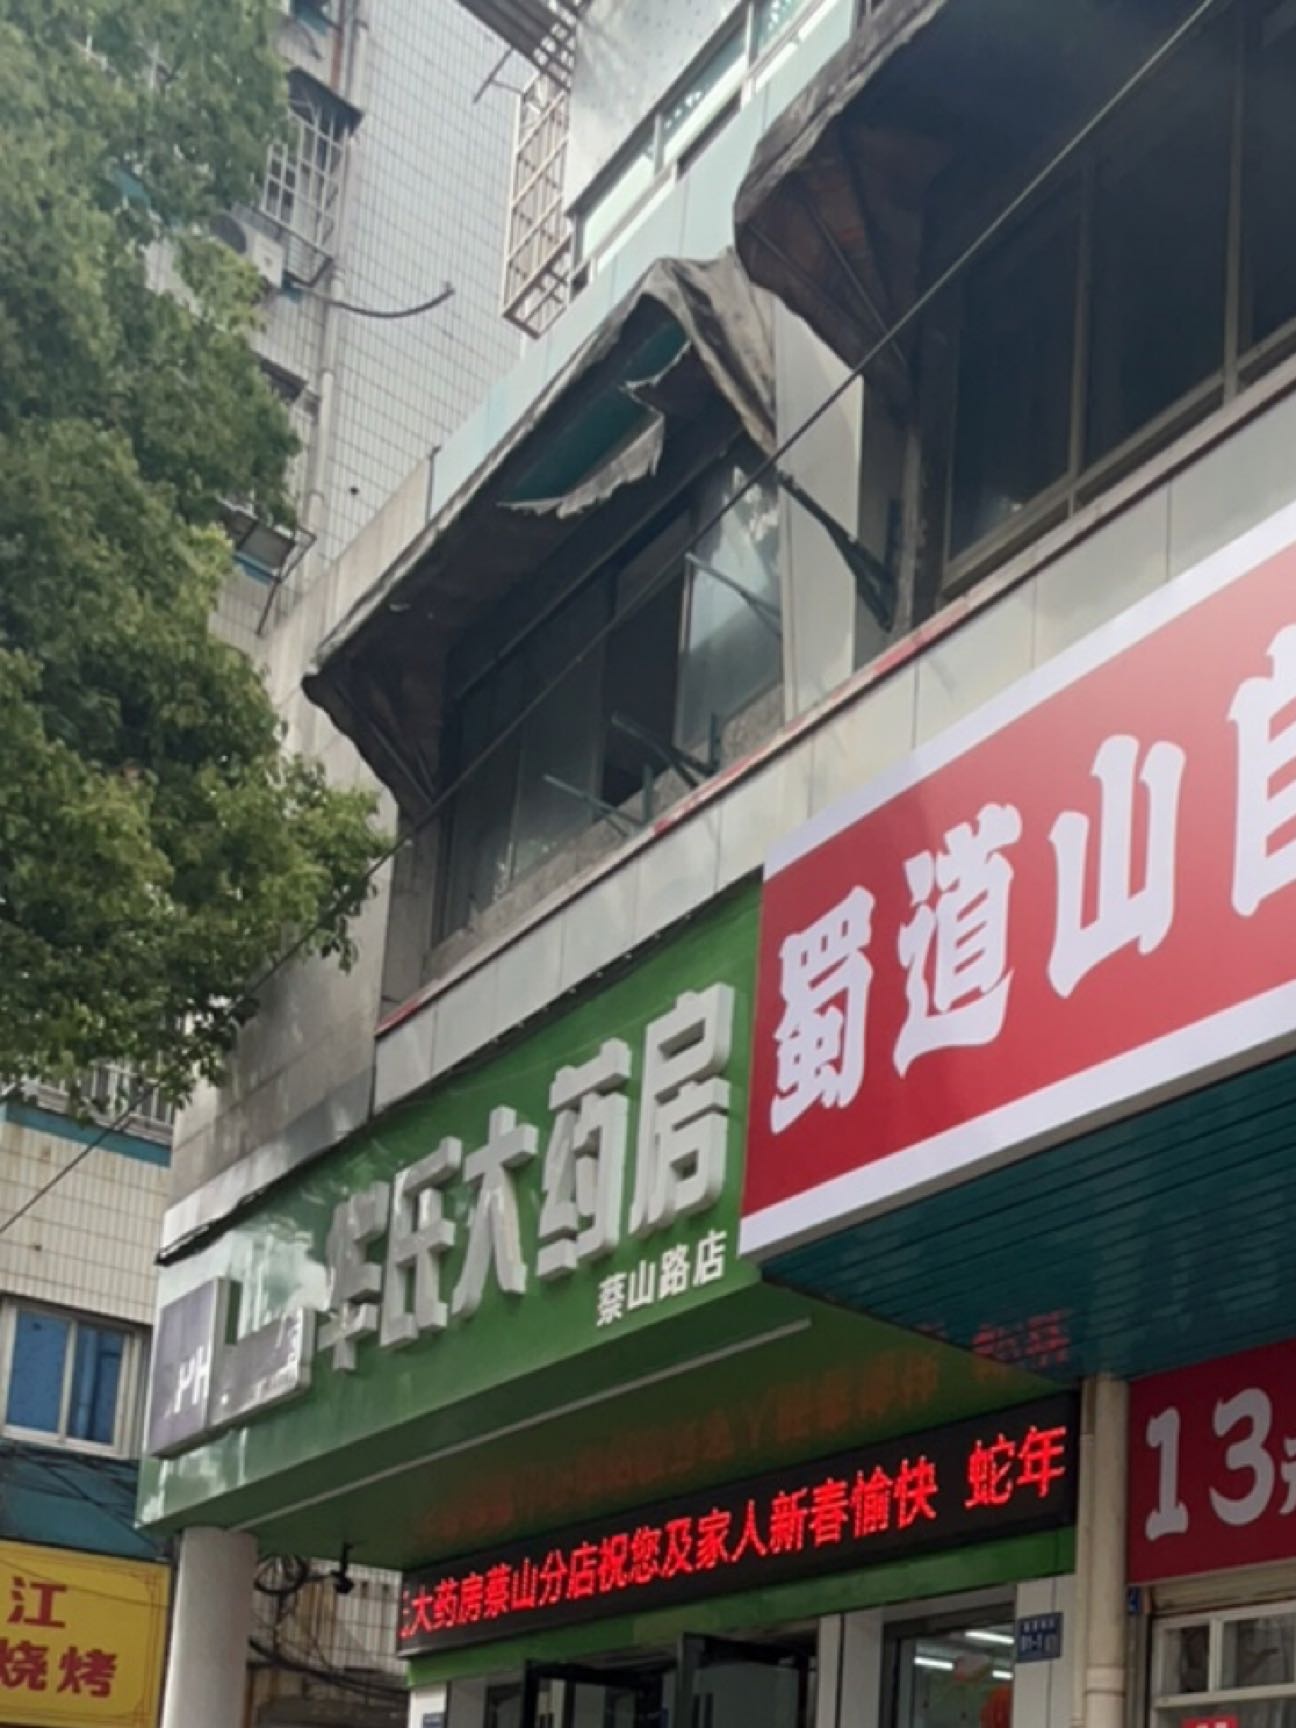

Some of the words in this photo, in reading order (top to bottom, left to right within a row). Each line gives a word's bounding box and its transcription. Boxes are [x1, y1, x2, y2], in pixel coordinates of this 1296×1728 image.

[964, 1425, 1067, 1510] 蛇年
[6, 1575, 68, 1630] 江
[0, 1635, 118, 1699] 烧烤
